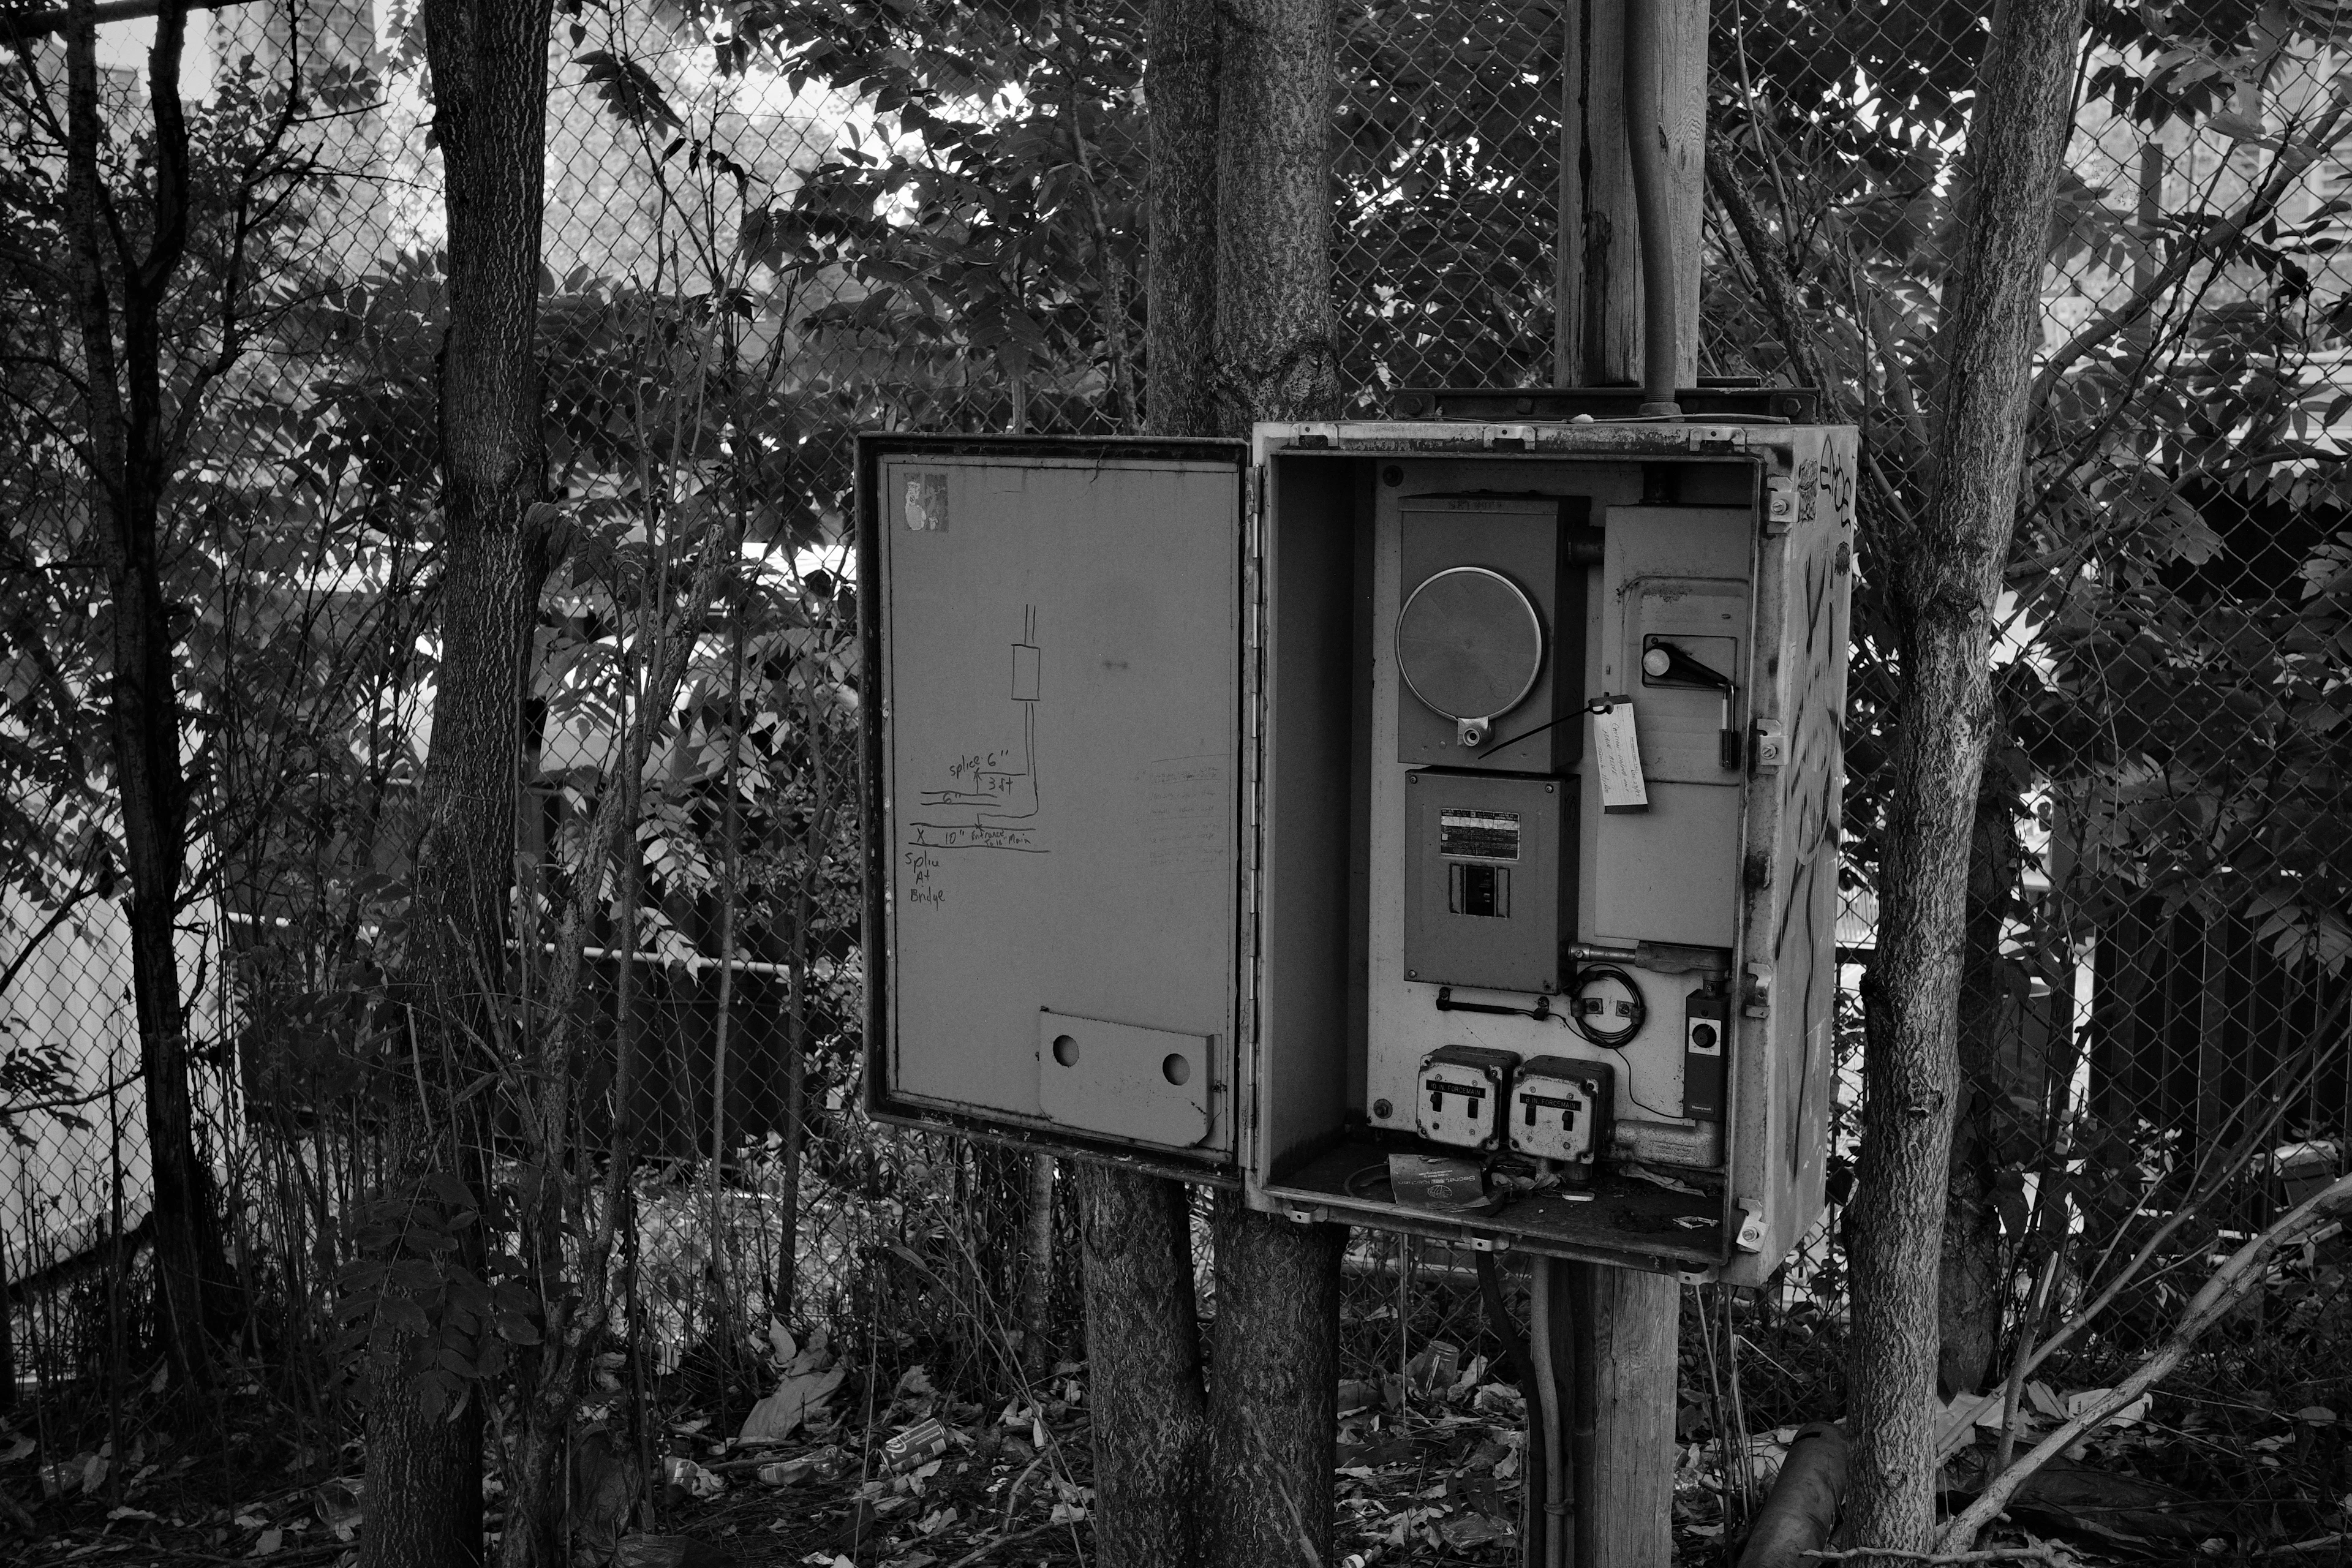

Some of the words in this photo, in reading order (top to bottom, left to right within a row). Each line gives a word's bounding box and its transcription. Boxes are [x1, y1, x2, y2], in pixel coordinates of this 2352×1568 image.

[1602, 729, 1612, 750] MAIN
[1447, 1085, 1481, 1096] FORCEMAIN
[1541, 1098, 1576, 1109] FORCEMAIN
